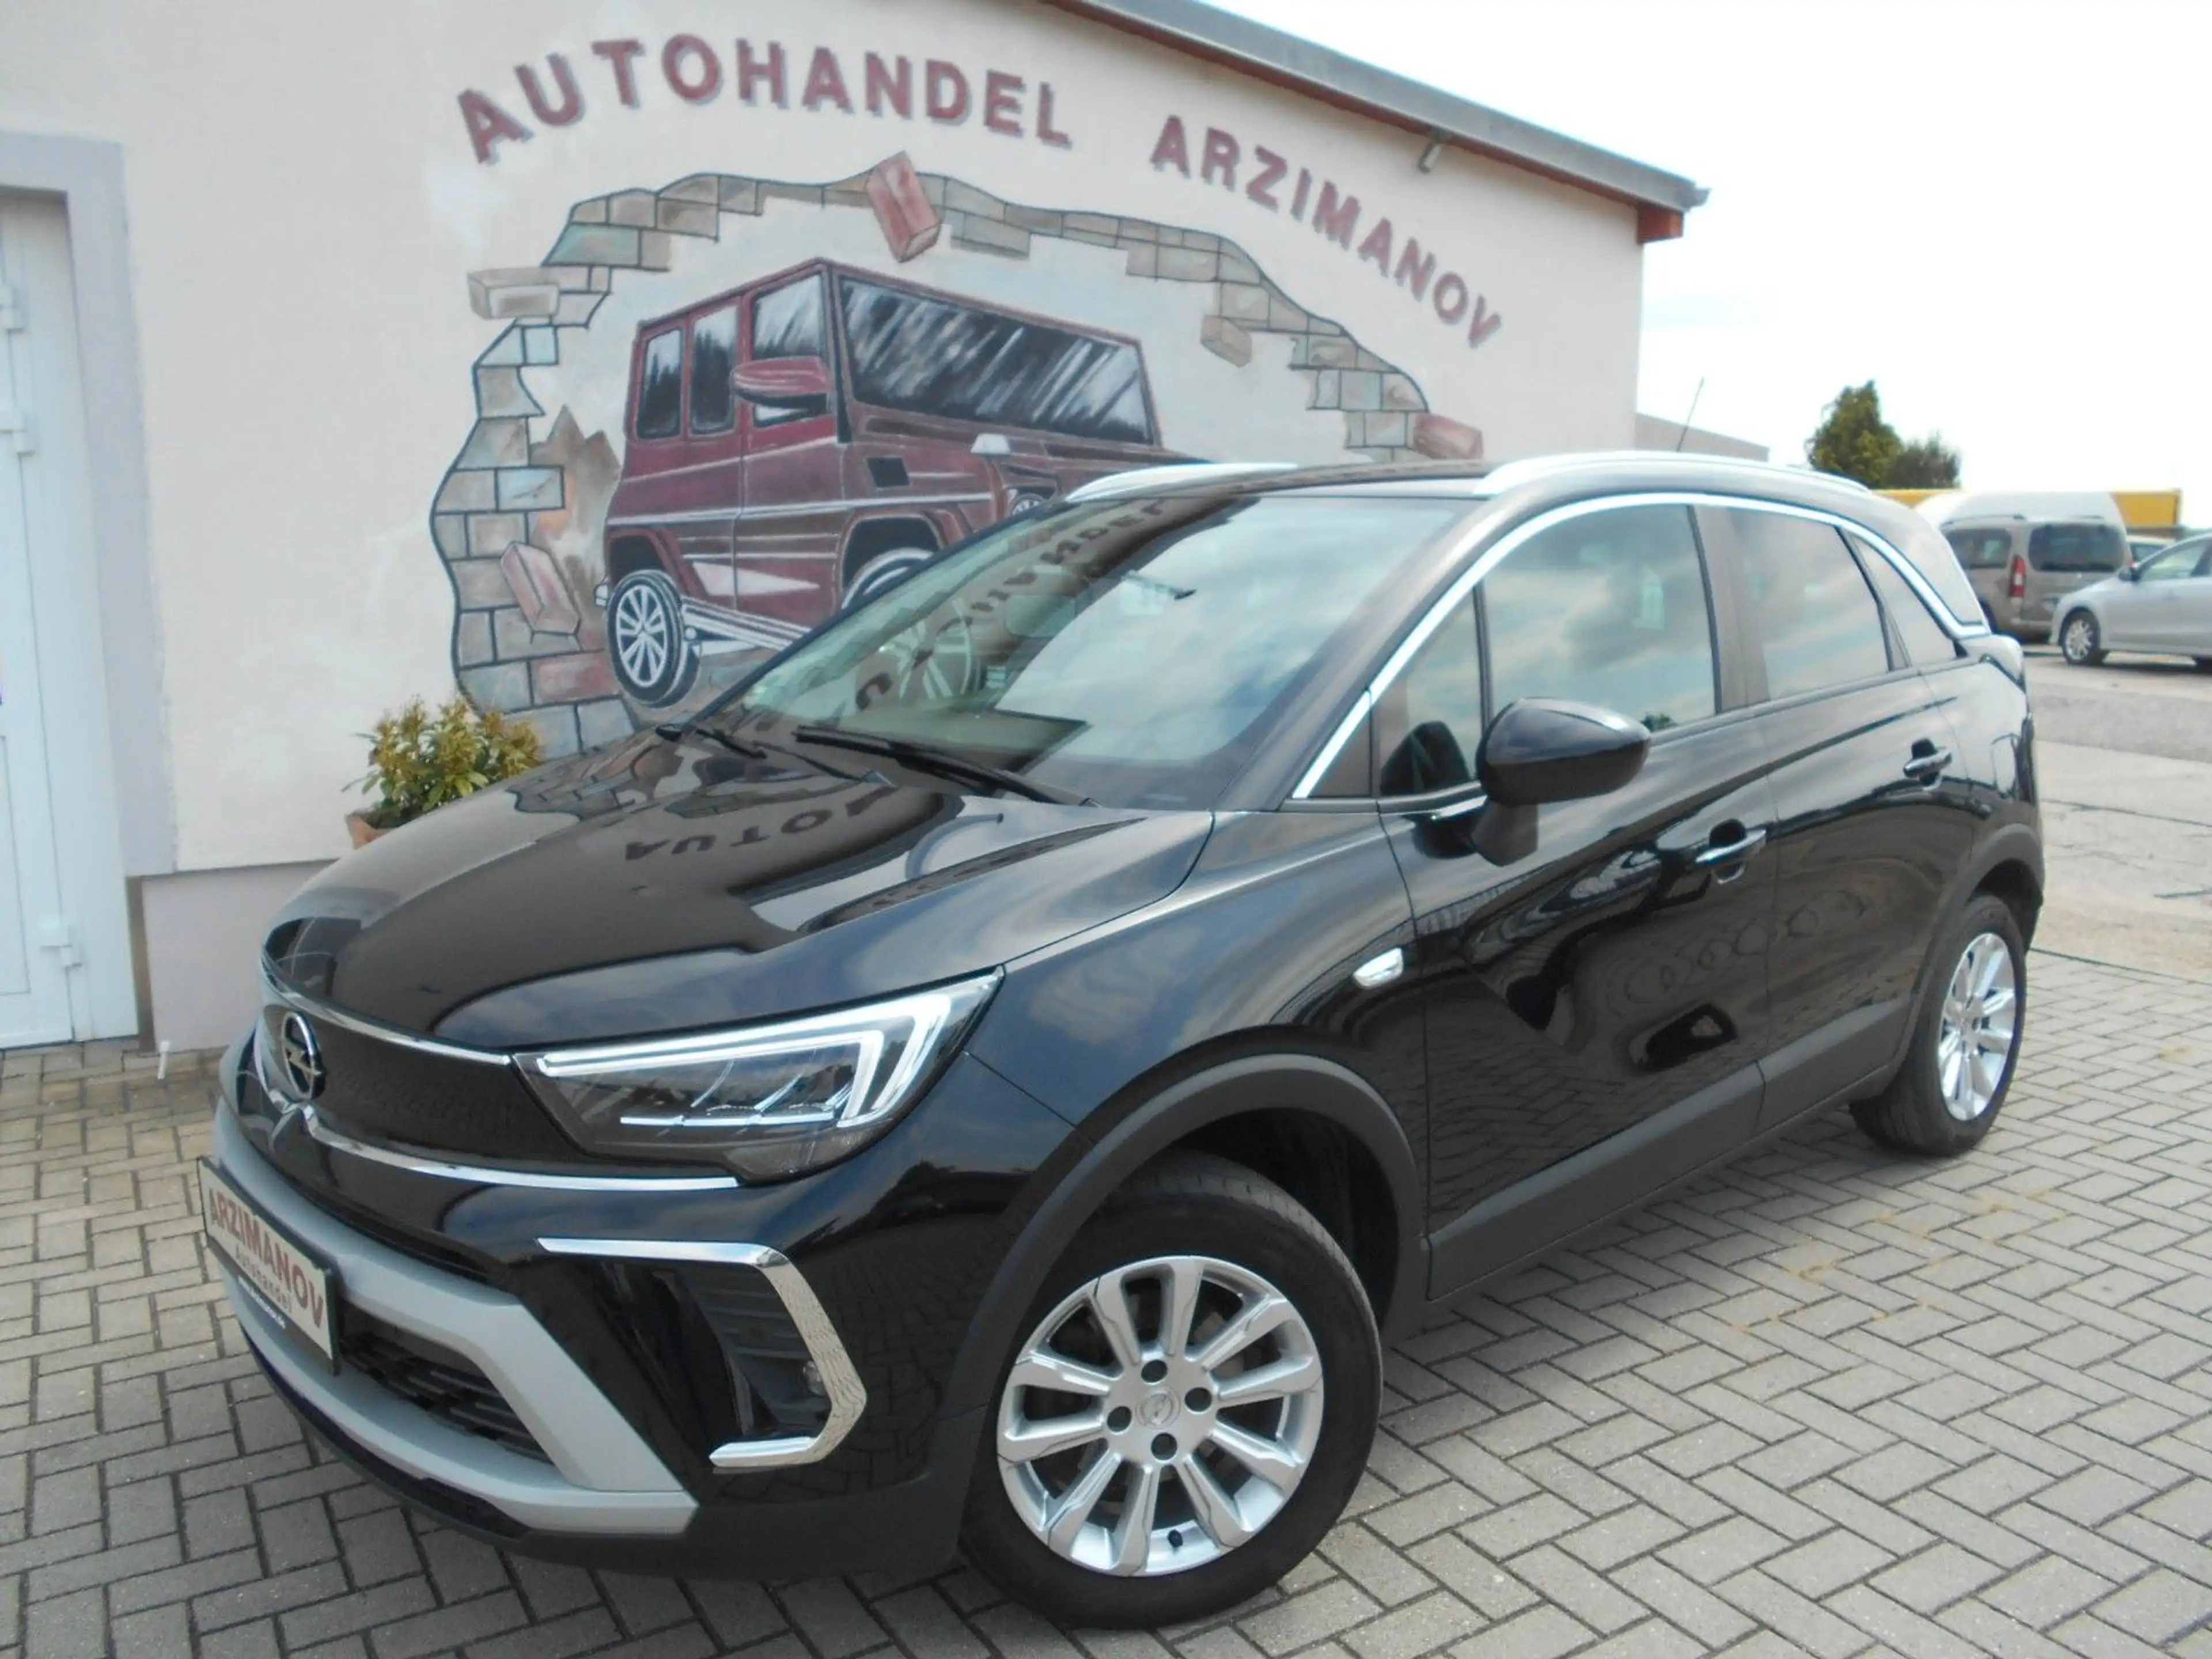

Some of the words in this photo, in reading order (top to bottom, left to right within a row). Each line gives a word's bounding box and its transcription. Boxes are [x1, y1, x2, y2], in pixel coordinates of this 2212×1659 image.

[457, 33, 1072, 163] AUTOHANDEL
[1149, 115, 1501, 348] ARZIMANOV
[209, 1188, 324, 1328] ARZIMANOV
